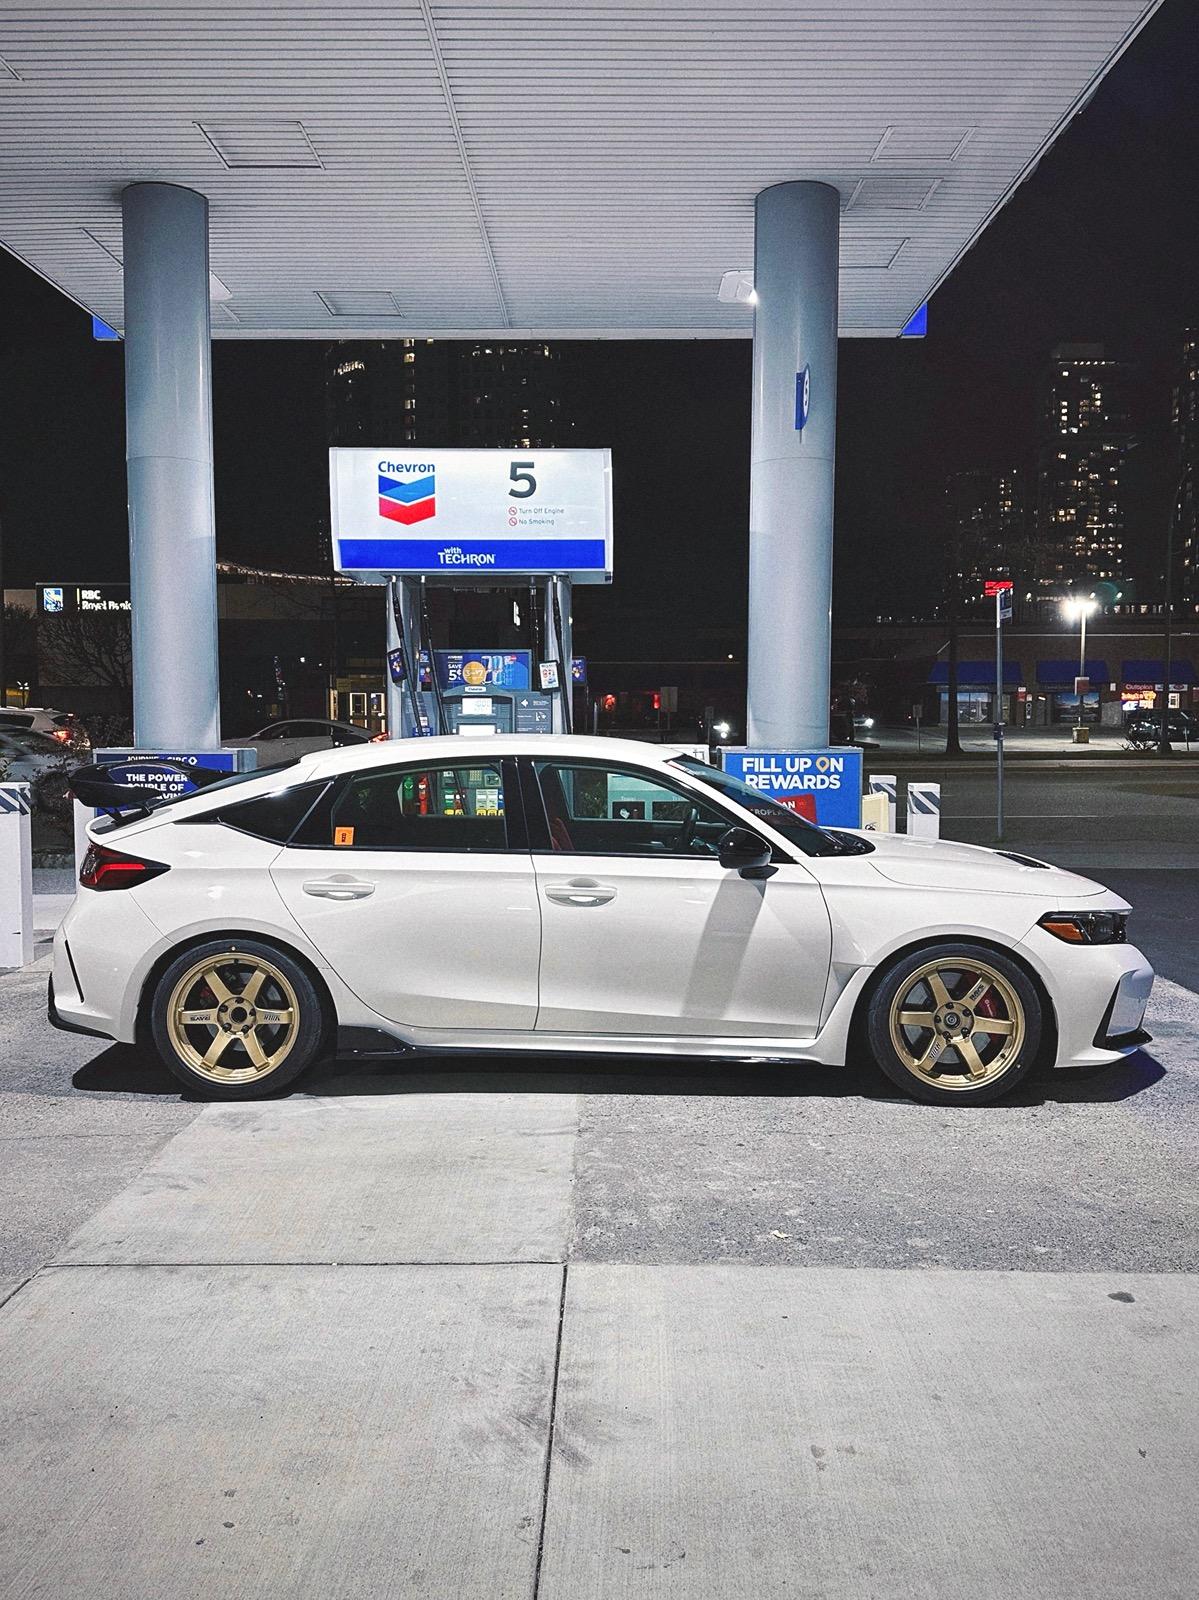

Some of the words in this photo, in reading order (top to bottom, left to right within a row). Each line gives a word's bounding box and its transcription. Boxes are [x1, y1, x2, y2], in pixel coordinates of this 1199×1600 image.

[378, 461, 435, 473] Chevron
[508, 462, 537, 498] 5
[529, 518, 555, 526] Smoking
[437, 552, 495, 567] TECHRON
[81, 590, 101, 600] RBC
[82, 601, 107, 611] Royal
[743, 758, 782, 773] FILL
[785, 758, 812, 773] UP
[126, 773, 146, 782] THE
[148, 773, 188, 782] POWER
[746, 775, 841, 790] REWARDS
[169, 783, 184, 791] OF
